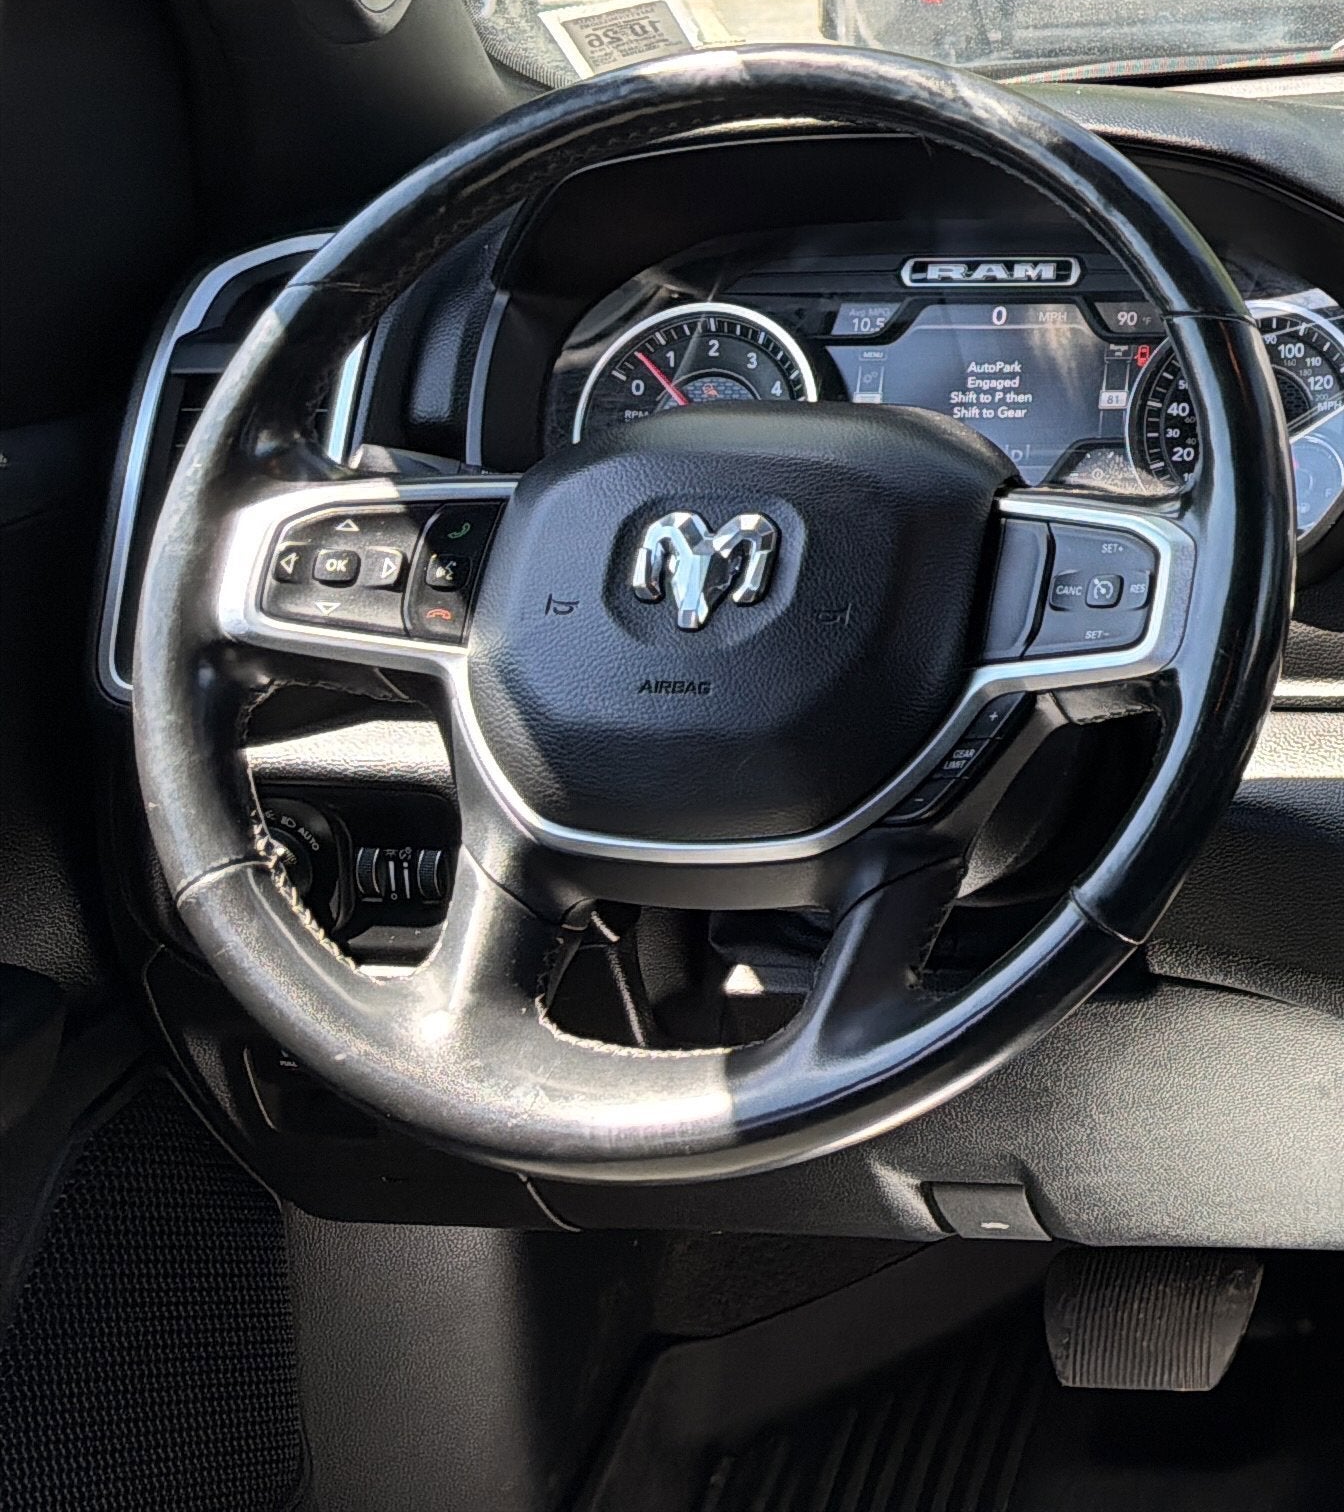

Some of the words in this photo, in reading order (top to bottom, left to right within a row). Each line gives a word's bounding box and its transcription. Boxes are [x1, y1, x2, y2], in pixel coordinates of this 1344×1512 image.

[926, 262, 1058, 281] RAM
[992, 306, 1007, 326] 0
[1038, 311, 1067, 323] MPH
[1117, 311, 1138, 326] 90
[852, 317, 886, 332] 10.5
[708, 339, 720, 357] 2
[1278, 343, 1305, 359] 100
[665, 350, 675, 367] 1
[746, 352, 758, 369] 3
[1305, 356, 1322, 367] 110
[967, 360, 1022, 373] AutoPark
[631, 379, 645, 396] 0
[770, 380, 783, 397] 4
[967, 376, 1020, 390] Engaged
[1307, 374, 1334, 391] 120
[950, 391, 977, 403] Shift
[979, 392, 992, 403] to
[994, 392, 1004, 403] P
[1005, 391, 1033, 403] then
[1106, 395, 1120, 405] 81
[953, 406, 980, 419] Shift
[982, 407, 995, 419] to
[997, 406, 1027, 418] Gear
[1167, 402, 1190, 417] 40
[1166, 428, 1180, 438] 30
[1172, 446, 1195, 462] 20
[326, 558, 348, 572] OK
[1056, 585, 1083, 596] CANC
[1130, 584, 1146, 594] RES
[639, 679, 712, 695] AIRBAG
[953, 748, 975, 759] GEAR
[298, 828, 320, 851] AUTO
